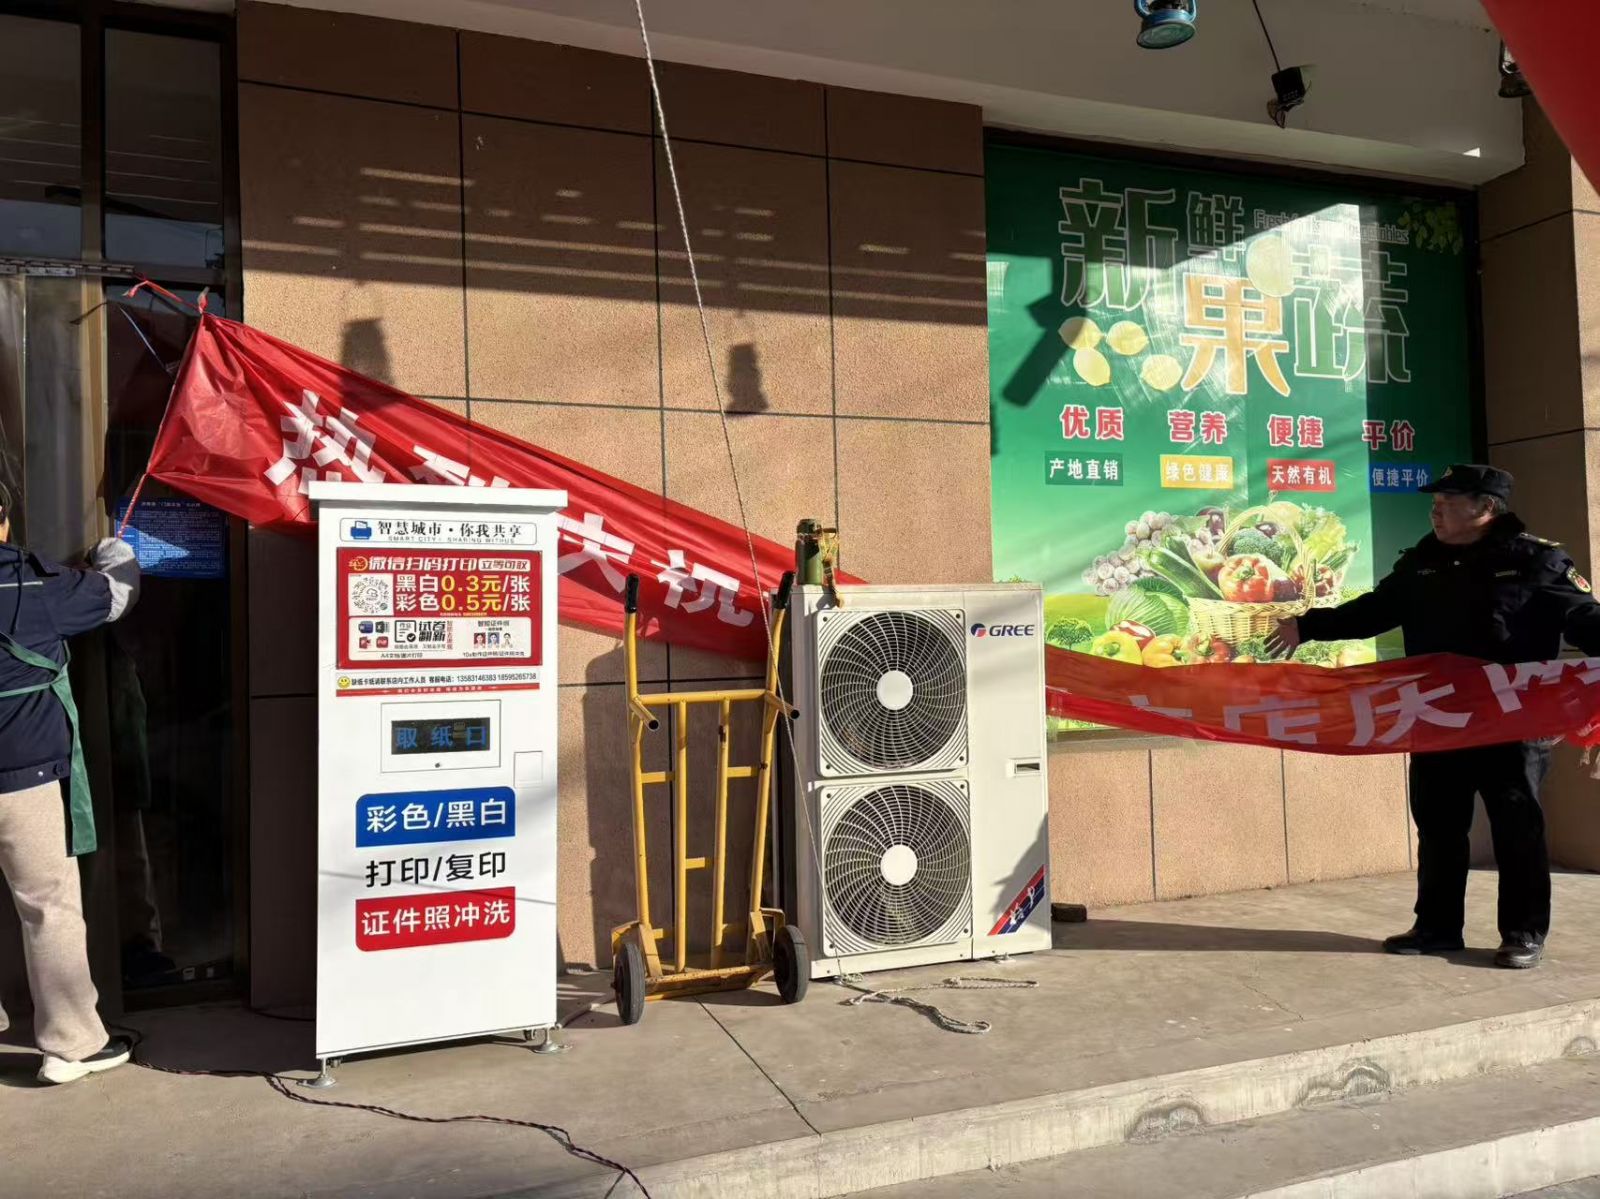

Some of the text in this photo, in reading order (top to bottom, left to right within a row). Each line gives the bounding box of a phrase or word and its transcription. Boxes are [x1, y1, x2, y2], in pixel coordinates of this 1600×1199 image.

[1060, 405, 1415, 451] 优质 营养 便捷 平价
[1049, 458, 1430, 488] 产地直销 绿色健康 天然有机 便捷平价
[368, 556, 478, 572] 微信扫码打印
[480, 560, 529, 571] 立等可取
[395, 574, 531, 593] 黑白0.3元/张
[395, 593, 531, 612] 彩色0.5元/张
[989, 624, 1035, 637] GREE
[395, 725, 487, 749] 取纸口
[366, 798, 507, 834] 彩色/黑白
[365, 851, 506, 888] 打印/复印
[361, 899, 511, 936] 证件照冲洗
